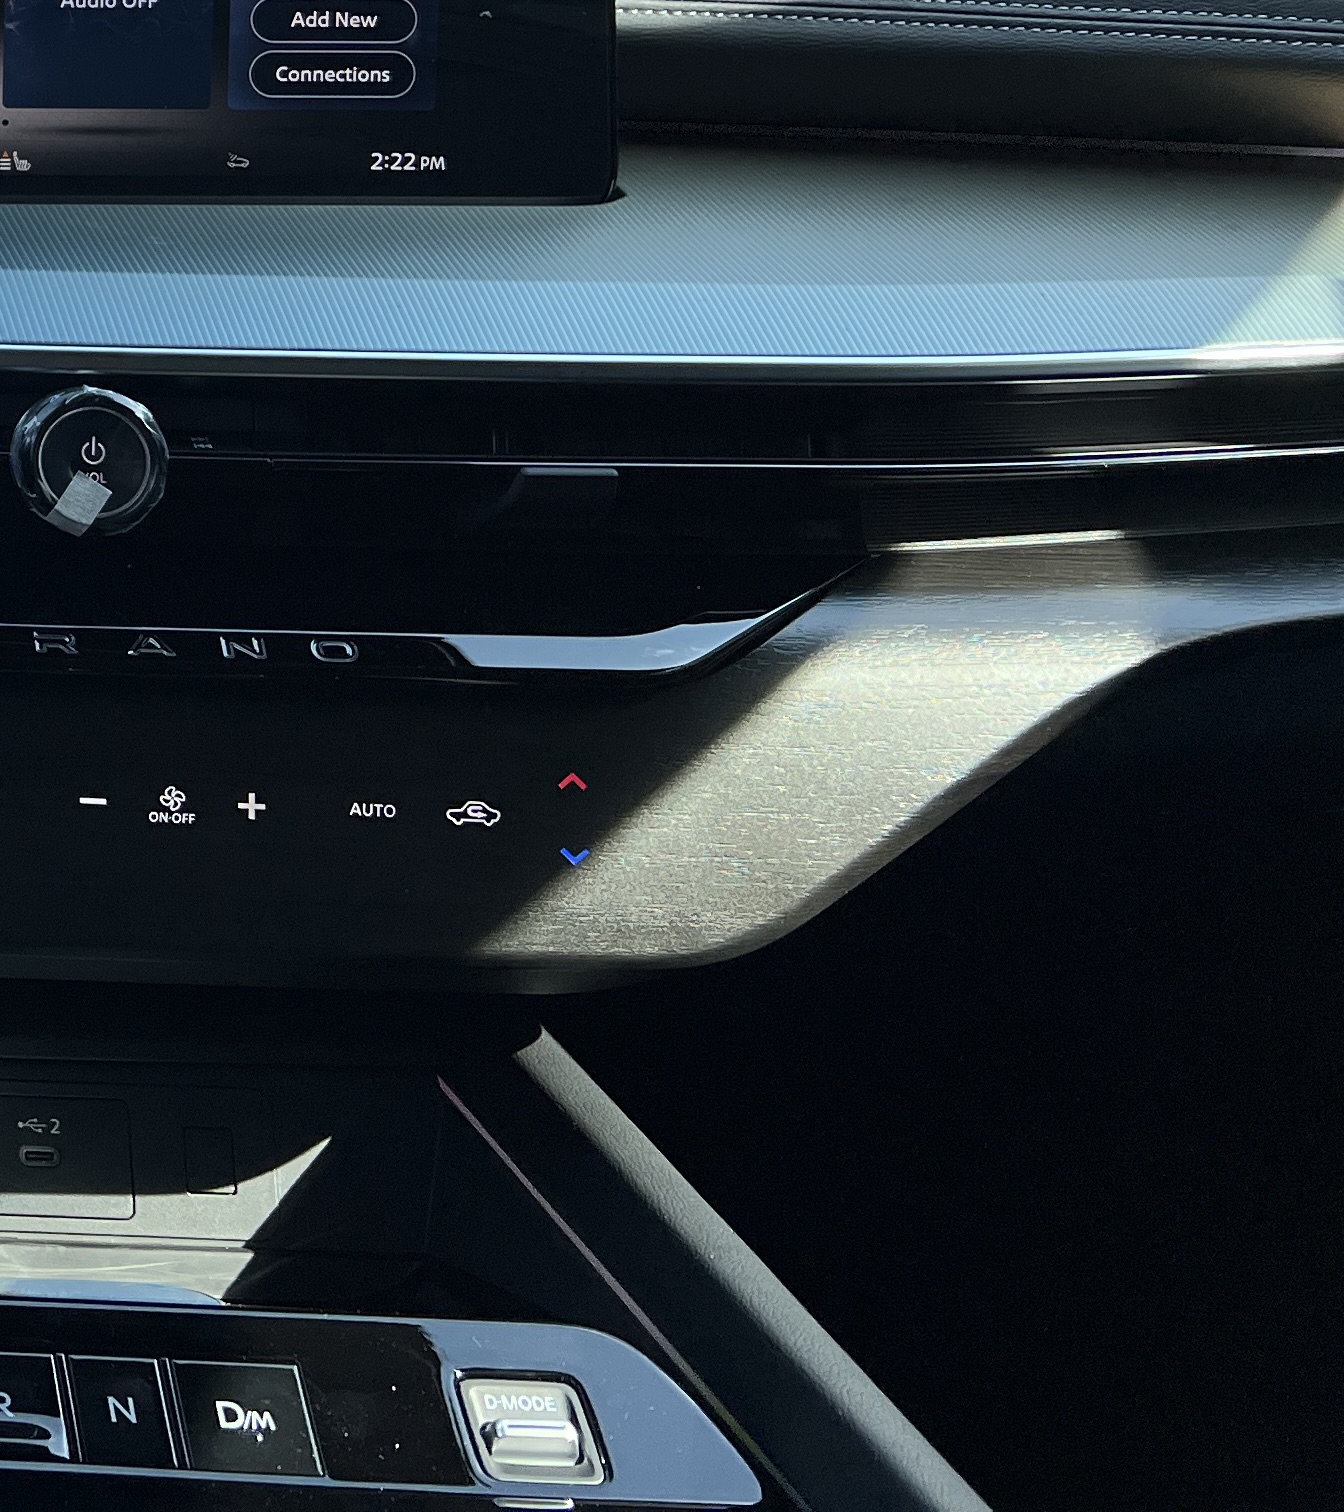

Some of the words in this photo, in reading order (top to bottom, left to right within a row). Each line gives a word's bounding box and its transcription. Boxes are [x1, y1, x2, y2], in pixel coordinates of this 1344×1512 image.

[290, 10, 330, 28] Add
[335, 11, 378, 28] New
[275, 65, 391, 83] Connections
[370, 152, 416, 171] 2:22
[420, 155, 446, 171] PM
[85, 471, 108, 484] OL
[349, 802, 397, 819] AUTO
[49, 1118, 61, 1135] 2
[106, 1395, 138, 1424] N
[483, 1393, 558, 1412] D-MODE
